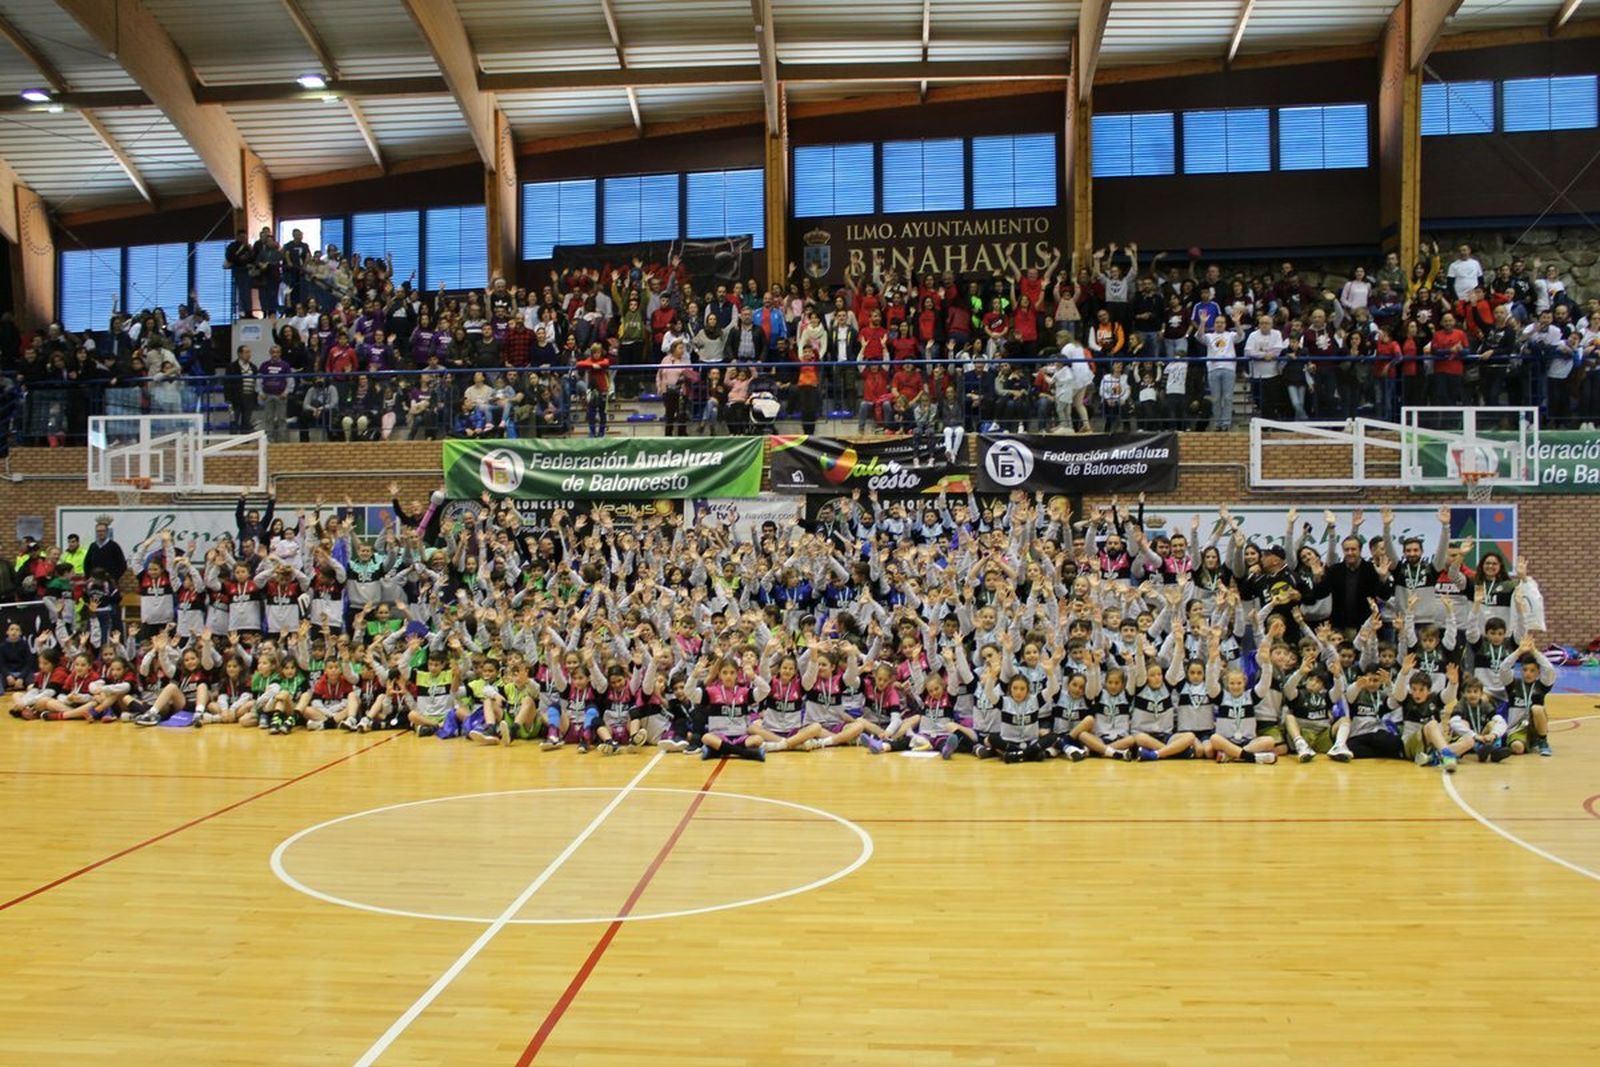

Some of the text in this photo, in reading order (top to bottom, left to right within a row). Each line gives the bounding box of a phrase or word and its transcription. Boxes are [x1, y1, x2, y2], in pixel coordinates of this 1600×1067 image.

[846, 216, 1050, 241] ILMO. AYUNTAMIENTO
[529, 448, 724, 470] Federación Andaluza
[1042, 448, 1169, 463] Federación Andaluza
[1065, 462, 1148, 476] de Baloncesto
[1542, 464, 1568, 484] de
[561, 473, 689, 492] de Baloncesto
[867, 469, 921, 490] cesto
